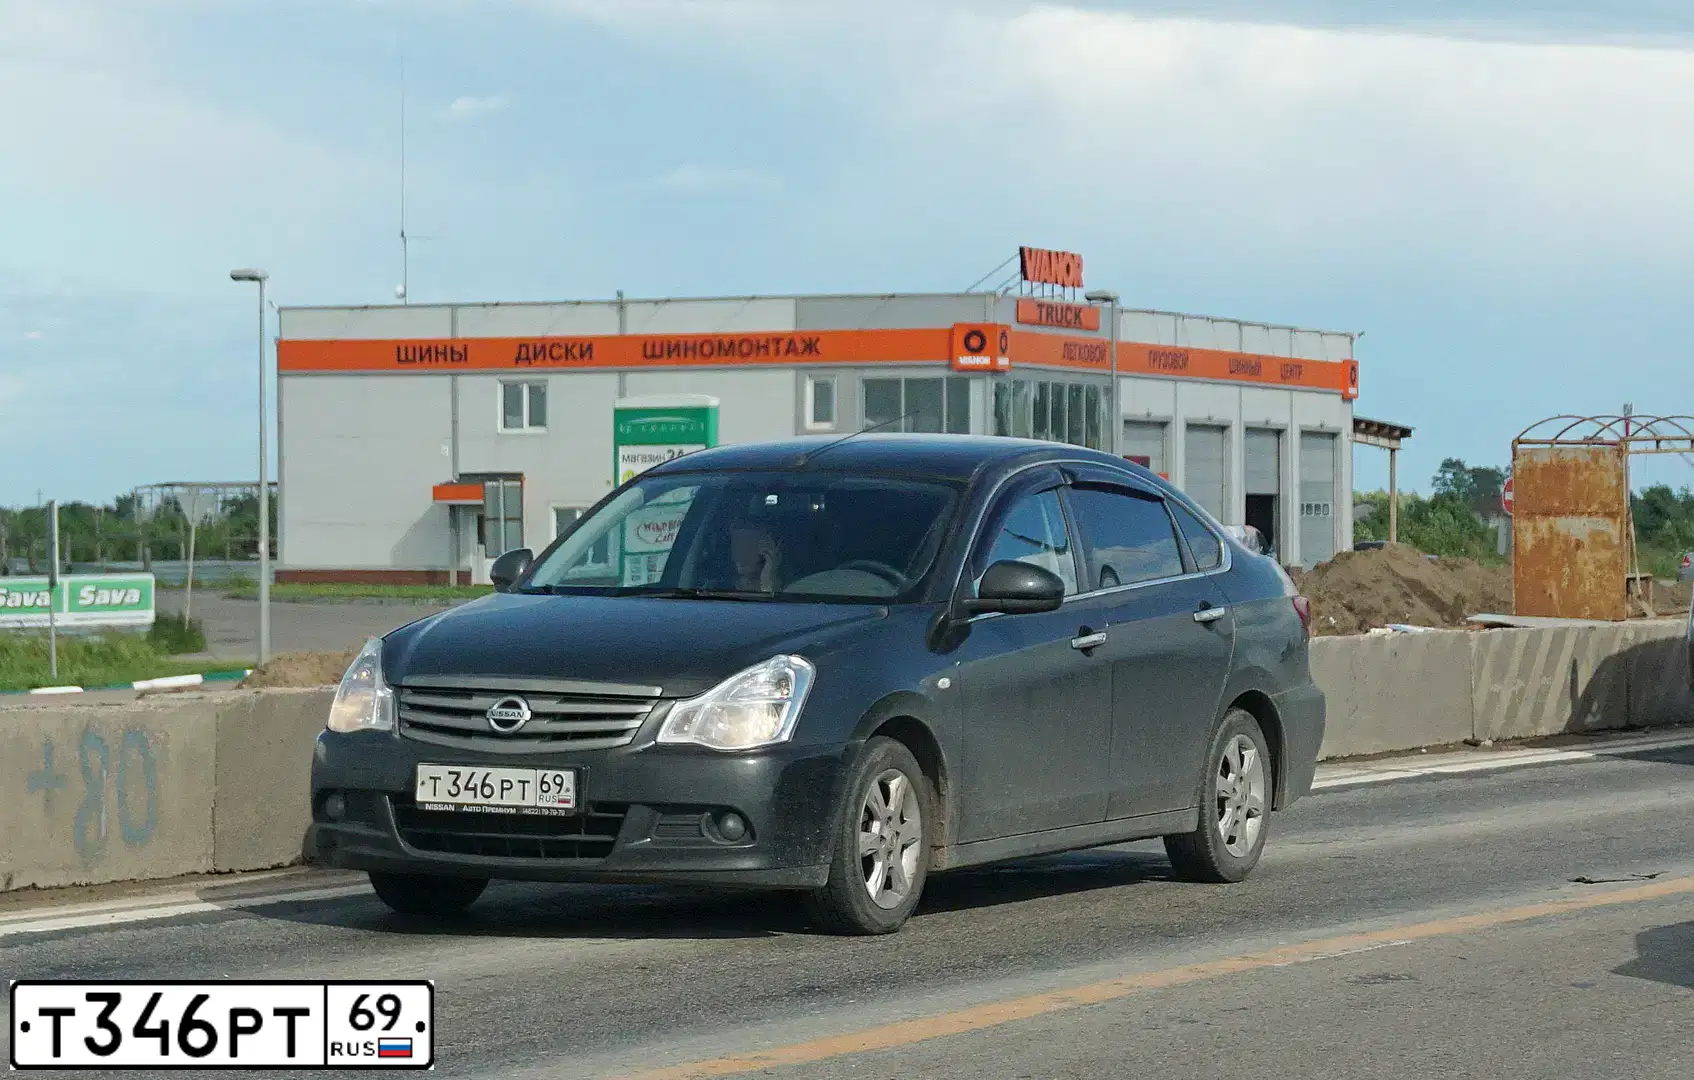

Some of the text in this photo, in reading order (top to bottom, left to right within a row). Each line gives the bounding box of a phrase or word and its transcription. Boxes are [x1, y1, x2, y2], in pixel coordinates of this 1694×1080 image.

[1020, 246, 1084, 288] VIANOR
[1037, 303, 1083, 327] TRUCK
[396, 336, 821, 364] ШИНЫ ДИСКИ ШИНОМОНТАЖ
[0, 587, 50, 607] Sava
[78, 584, 141, 606] Sava
[429, 770, 531, 801] Т346РТ
[540, 772, 565, 794] 69
[425, 803, 455, 811] NISSAN
[538, 794, 557, 803] RUS
